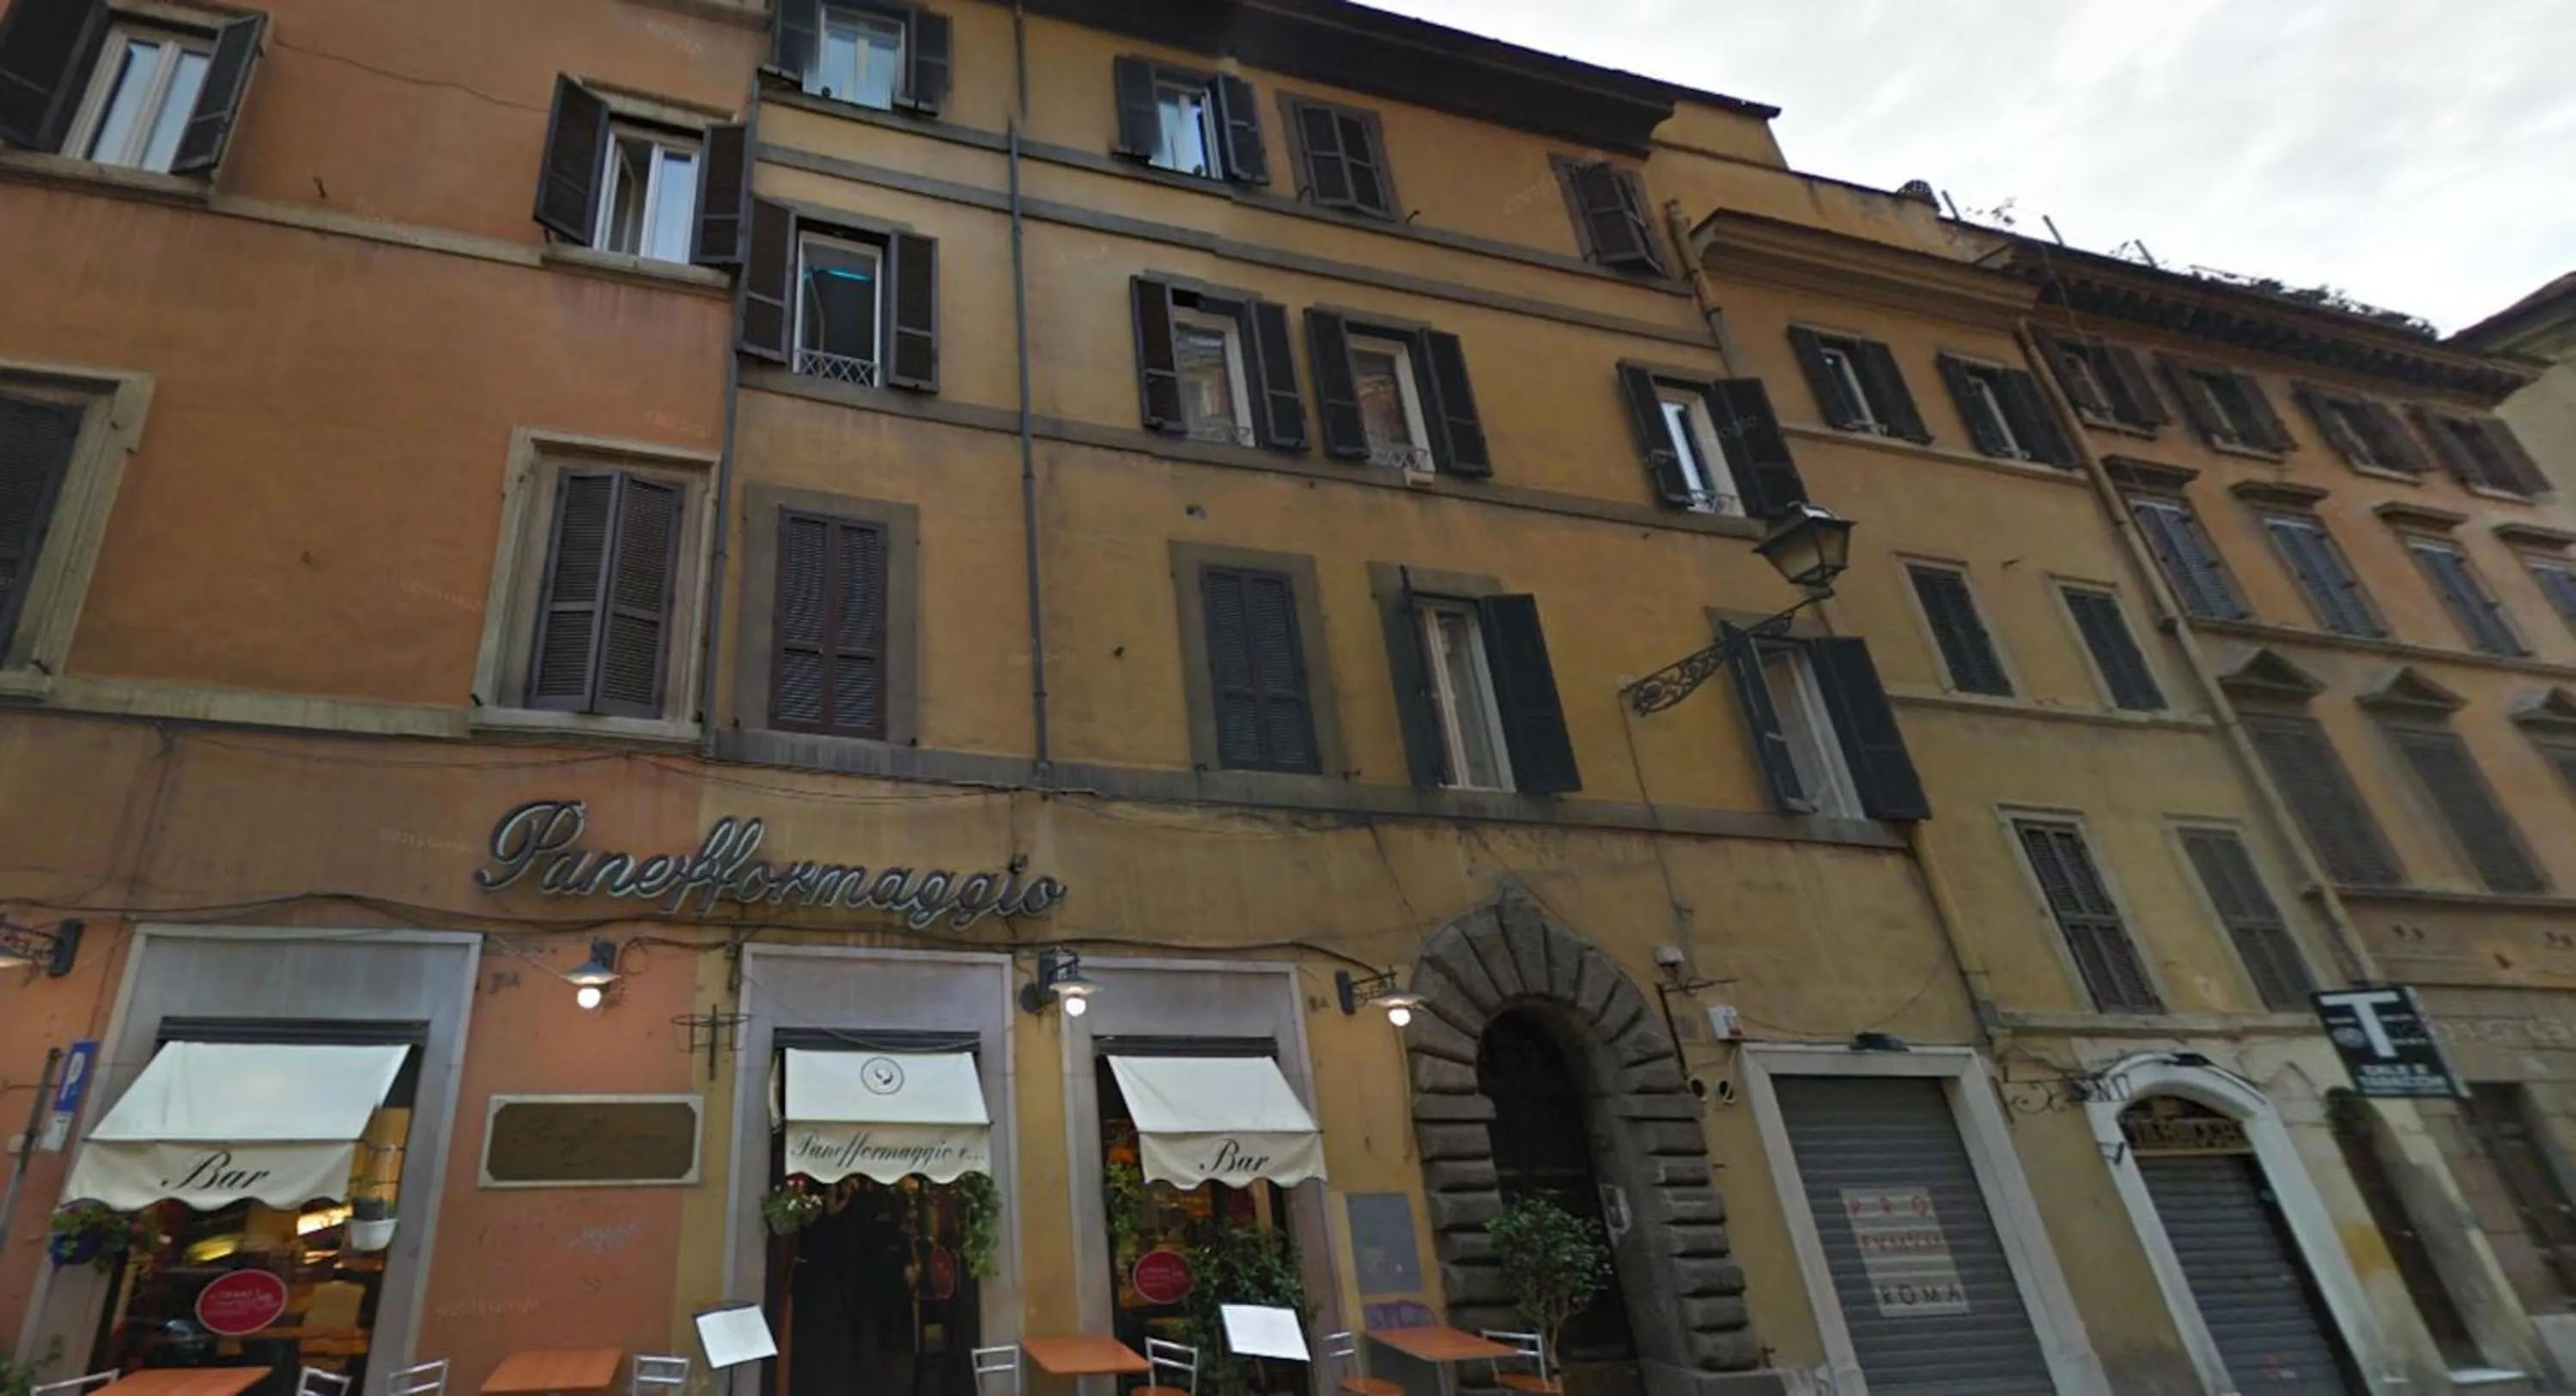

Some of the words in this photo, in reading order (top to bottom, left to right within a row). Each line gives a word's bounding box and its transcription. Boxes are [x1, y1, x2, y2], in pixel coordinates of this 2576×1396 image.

[2318, 990, 2401, 1058] T
[161, 1150, 270, 1190] Bar
[1200, 1137, 1270, 1173] Bar
